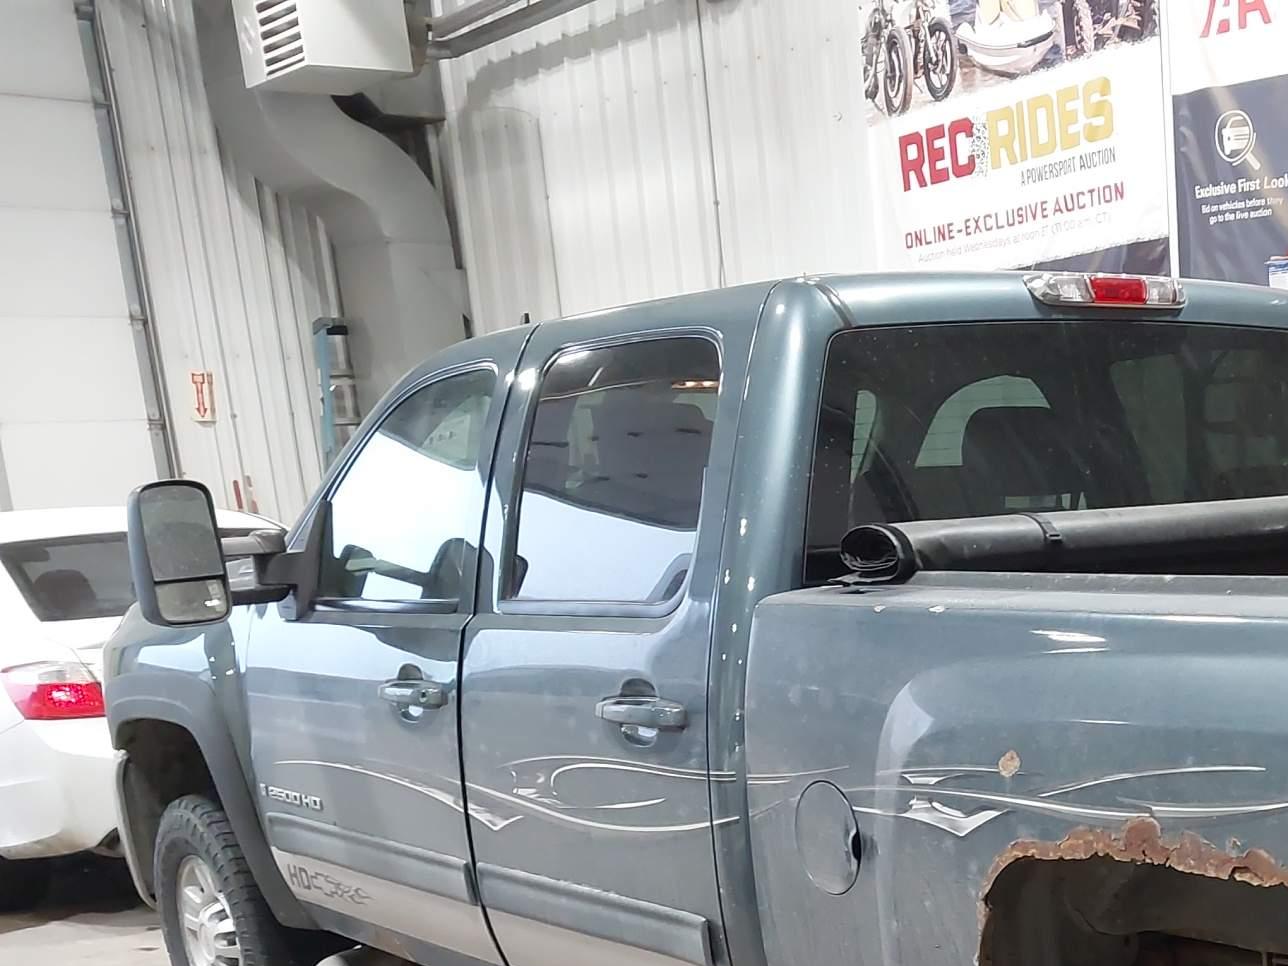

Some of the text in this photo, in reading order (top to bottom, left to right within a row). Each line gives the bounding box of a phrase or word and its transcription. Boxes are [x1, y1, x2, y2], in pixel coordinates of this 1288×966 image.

[899, 76, 1114, 192] REC RIDES
[1026, 156, 1076, 185] POWERSPORT
[1079, 146, 1116, 171] AUCTION
[1194, 181, 1236, 200] Exclusive
[1238, 178, 1260, 193] First
[905, 180, 1125, 249] ONLINE-EXCLUSIVE AUCTION
[1201, 203, 1210, 214] Bid
[1211, 204, 1219, 213] on
[1219, 200, 1245, 211] vehicles
[1246, 197, 1265, 208] before
[1209, 208, 1272, 226] go to the live auction
